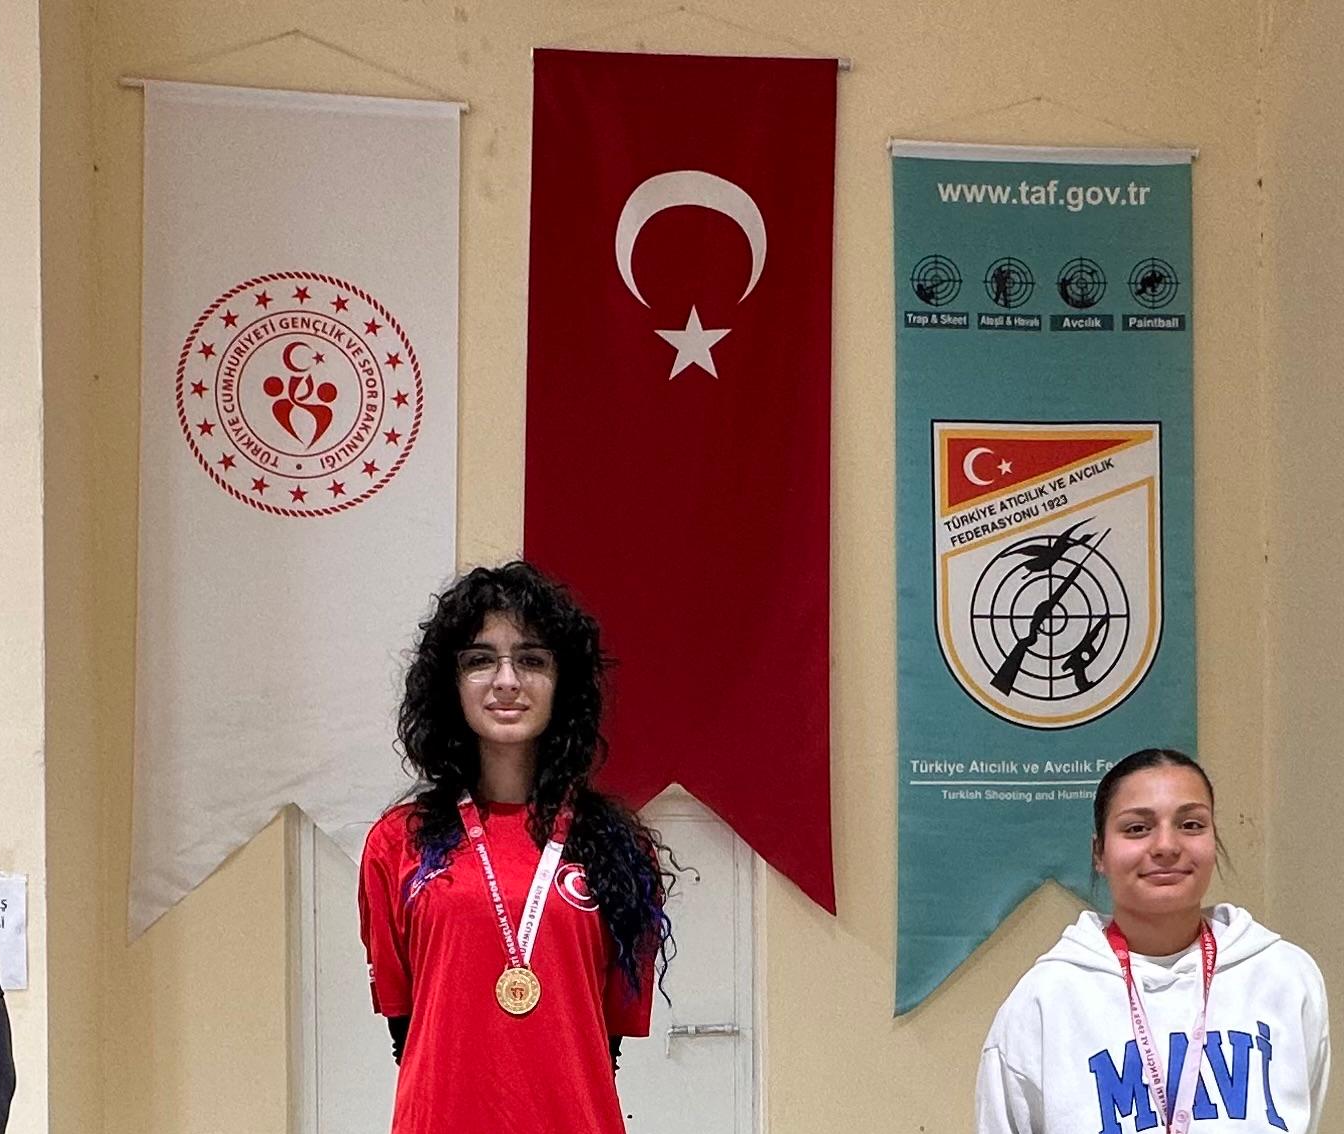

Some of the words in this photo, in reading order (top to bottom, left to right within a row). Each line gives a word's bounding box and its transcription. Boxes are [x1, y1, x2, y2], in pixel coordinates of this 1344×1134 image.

[937, 180, 1150, 211] www.taf.gov.tr
[279, 316, 346, 343] GENÇLİK
[906, 313, 928, 325] Trap
[930, 315, 938, 325] &
[940, 314, 967, 325] Skeet
[1129, 317, 1179, 328] Paintball
[345, 338, 364, 358] VE
[221, 319, 276, 413] CUMHURİYETİ
[358, 358, 378, 399] SPOR
[227, 416, 280, 469] TÜRKİYE
[320, 404, 378, 469] BAKANLIĞI
[944, 504, 997, 532] TÜRKİYE
[1000, 486, 1049, 512] ATICILIK
[1049, 478, 1067, 492] VE
[1069, 458, 1114, 484] AVCILIK
[950, 505, 1040, 547] FEDERASYONU
[1041, 494, 1068, 512] 1923
[910, 760, 964, 776] Türkiye
[969, 760, 1018, 774] Atıcılık
[1023, 762, 1039, 774] ve
[1044, 759, 1092, 774] Avcılık
[941, 789, 982, 800] Turkish
[984, 789, 1033, 803] Shooting
[1035, 789, 1055, 800] and
